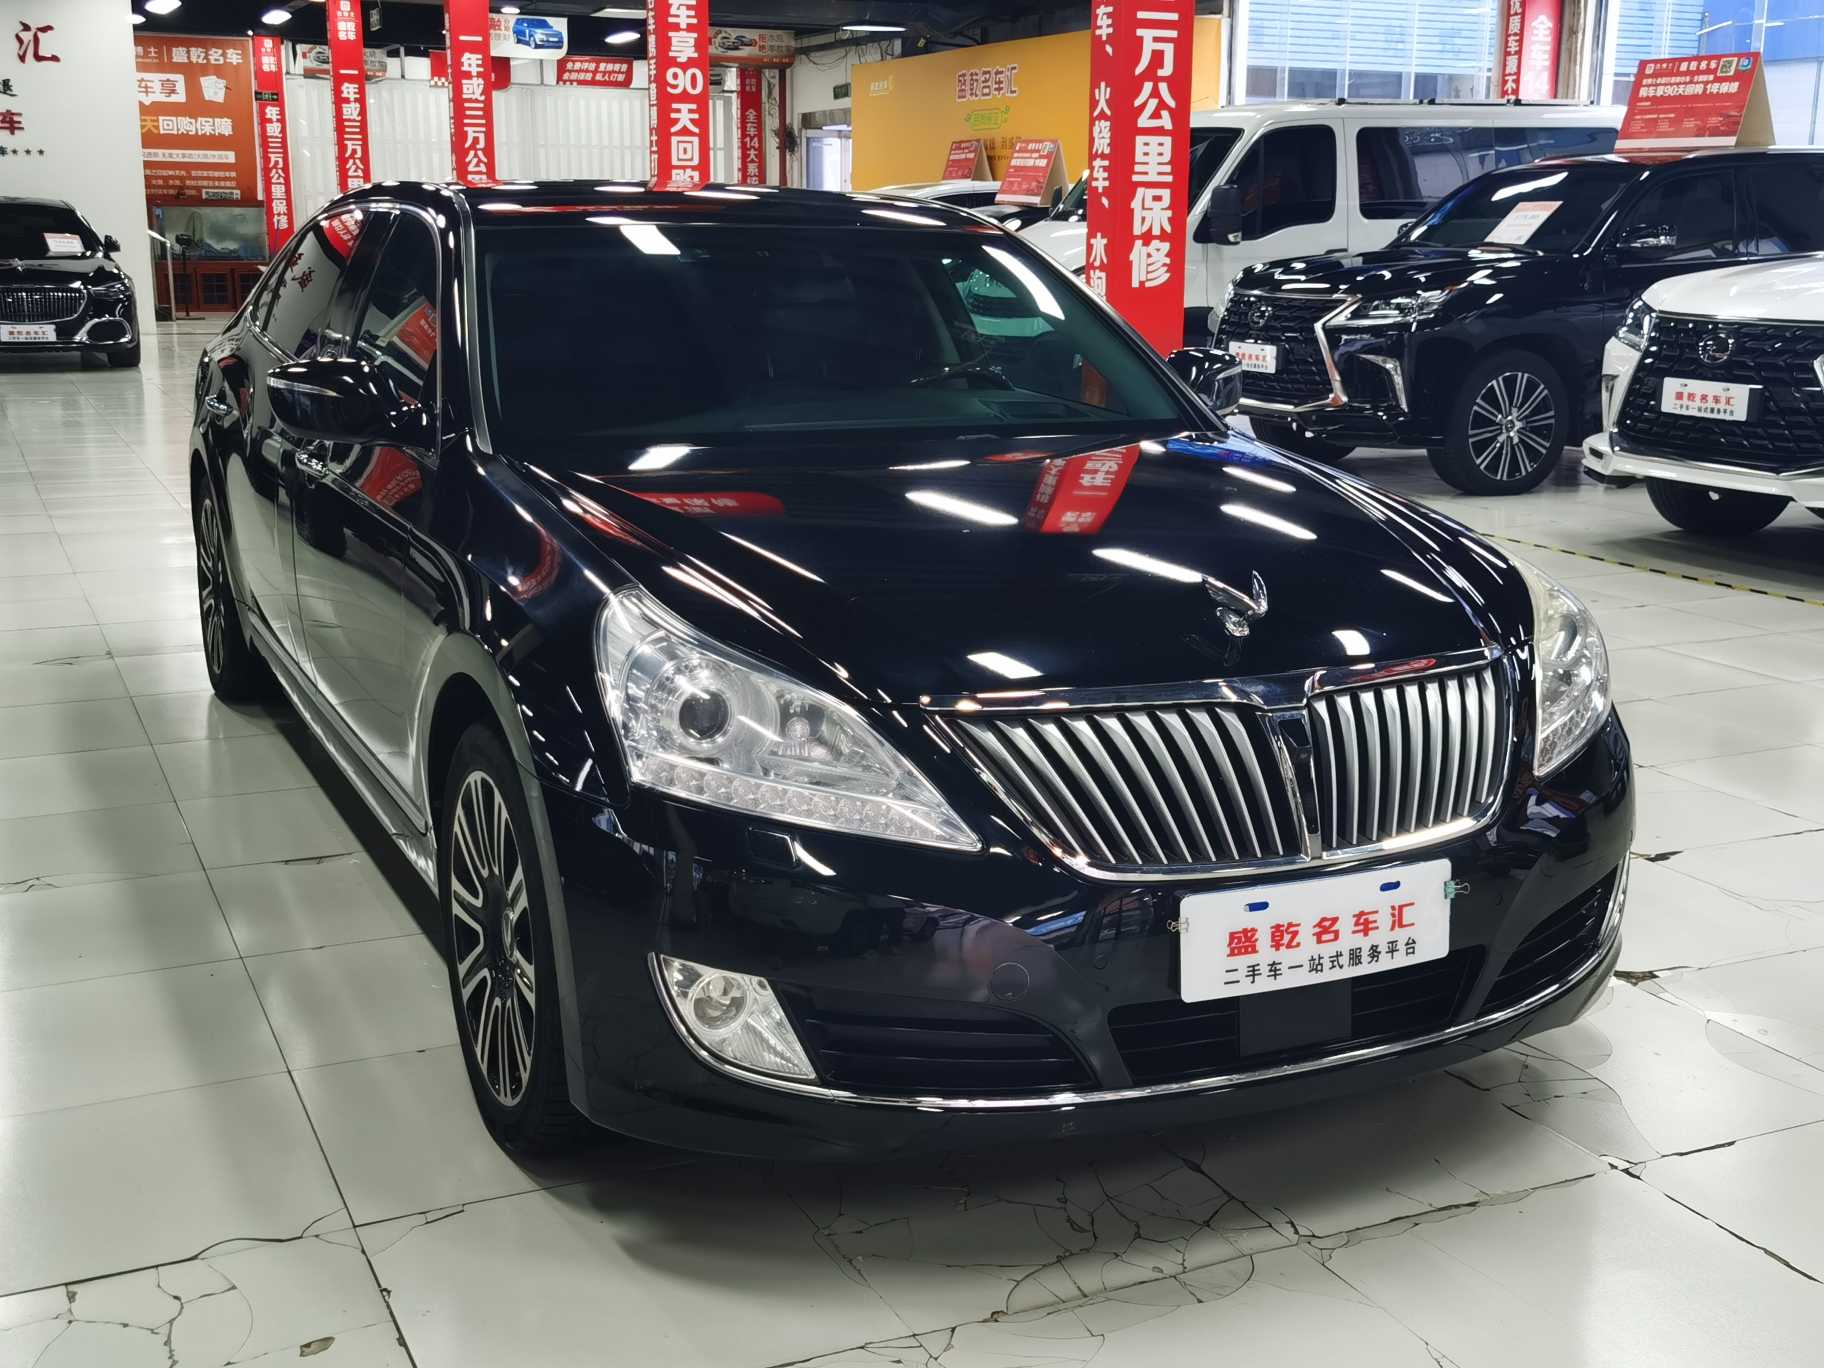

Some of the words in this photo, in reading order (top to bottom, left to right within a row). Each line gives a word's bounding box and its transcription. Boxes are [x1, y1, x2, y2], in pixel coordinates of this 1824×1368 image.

[15, 20, 61, 64] 汇
[171, 46, 244, 65] 盛乾名车
[956, 65, 1019, 101] 盛乾名车汇
[1226, 901, 1417, 958] 盛乾名车汇
[1223, 937, 1418, 986] 二手车一站式服务平台
